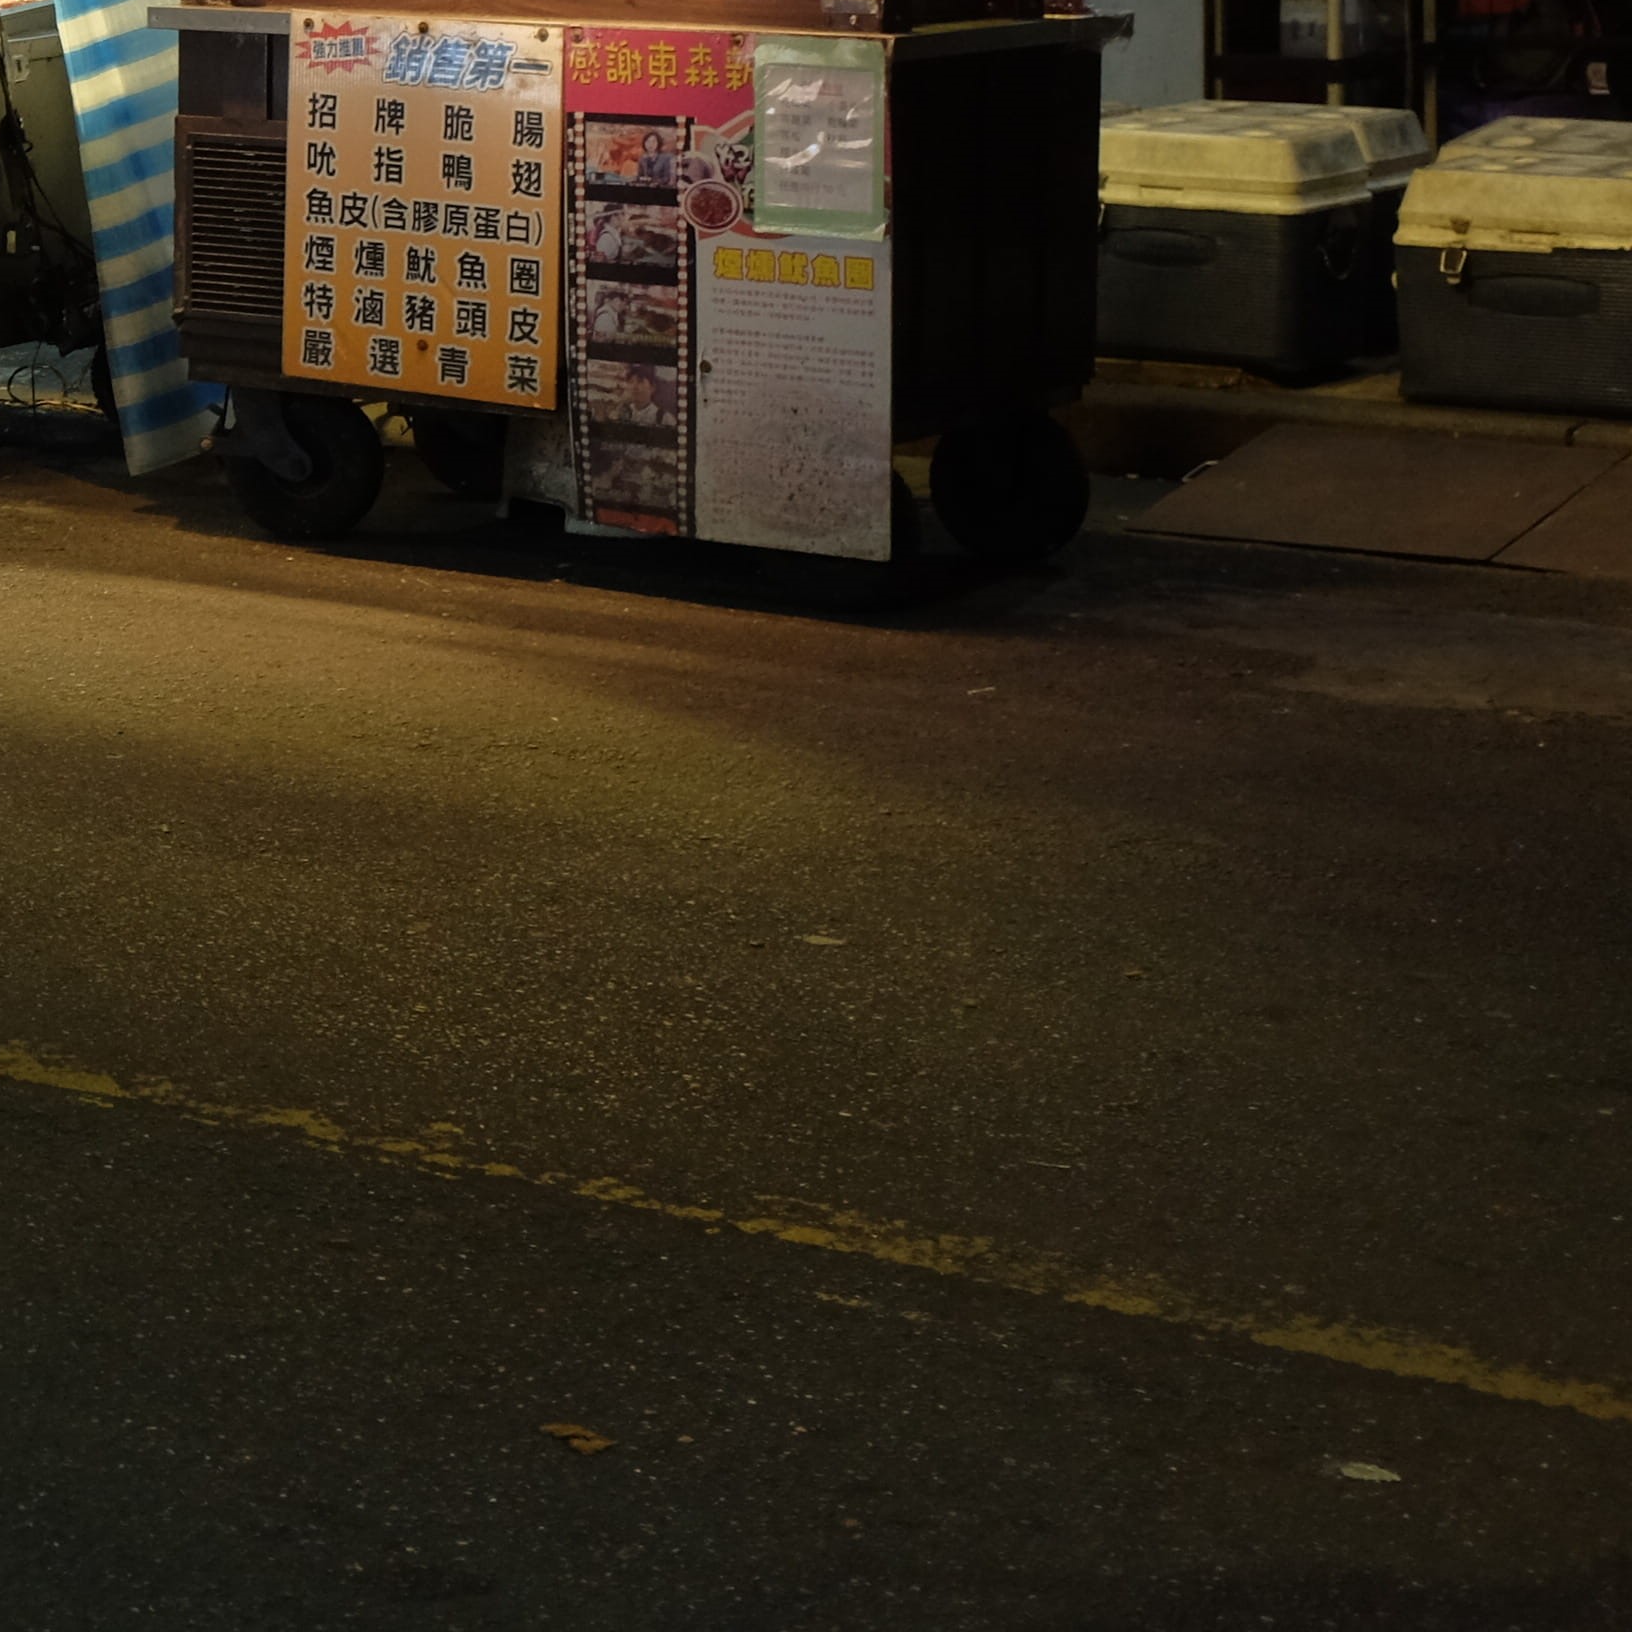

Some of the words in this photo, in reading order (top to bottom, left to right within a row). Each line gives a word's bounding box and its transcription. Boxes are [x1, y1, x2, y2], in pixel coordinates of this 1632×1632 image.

[384, 31, 552, 91] 銷售第一
[307, 92, 545, 149] 招牌脆腸
[307, 141, 543, 198] 吮指鴨翅
[305, 188, 543, 246] 魚皮(含膠原蛋白)
[304, 234, 541, 297] 煙燻魷魚圈
[303, 282, 540, 345] 特滷豬頭皮
[302, 329, 539, 393] 嚴選青菜
